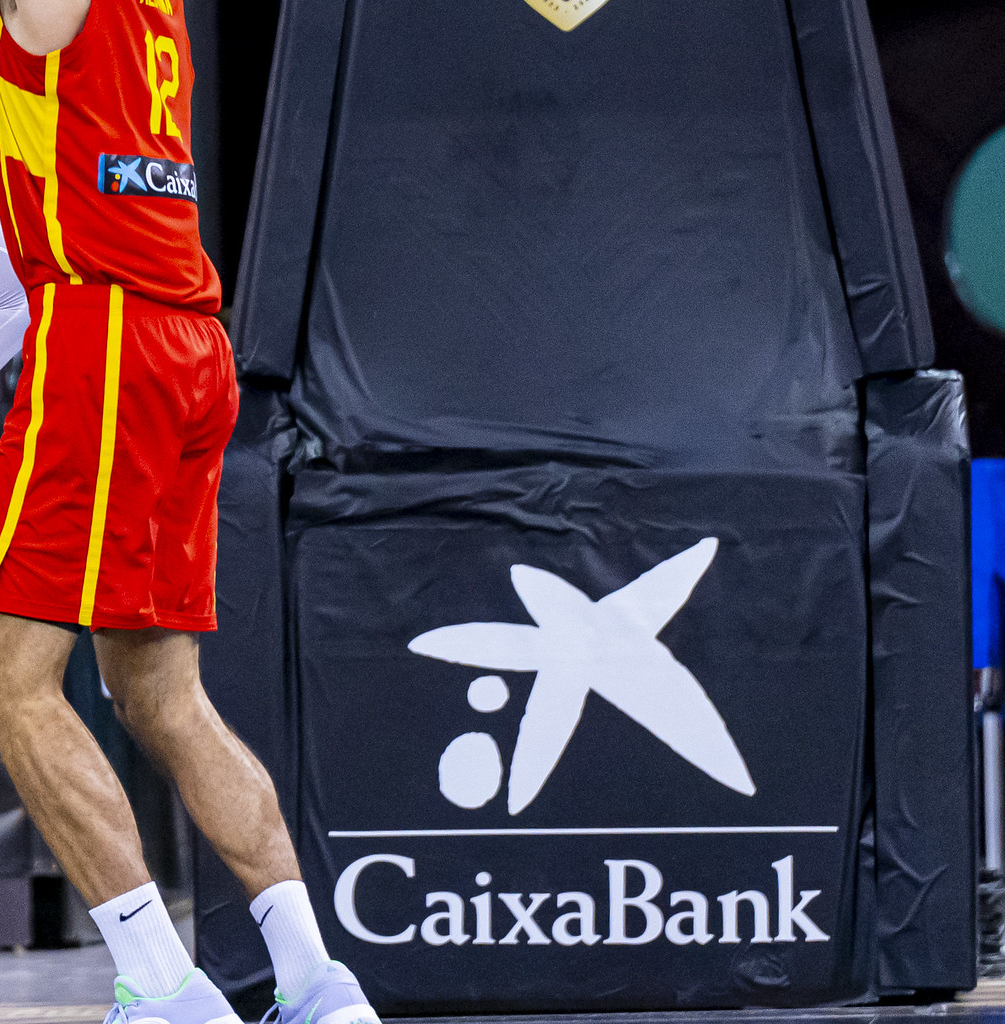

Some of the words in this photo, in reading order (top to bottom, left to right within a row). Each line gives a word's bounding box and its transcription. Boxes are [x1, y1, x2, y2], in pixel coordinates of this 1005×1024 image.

[144, 29, 184, 145] 12
[145, 161, 198, 202] Caixa
[333, 852, 831, 947] CaixaBank
